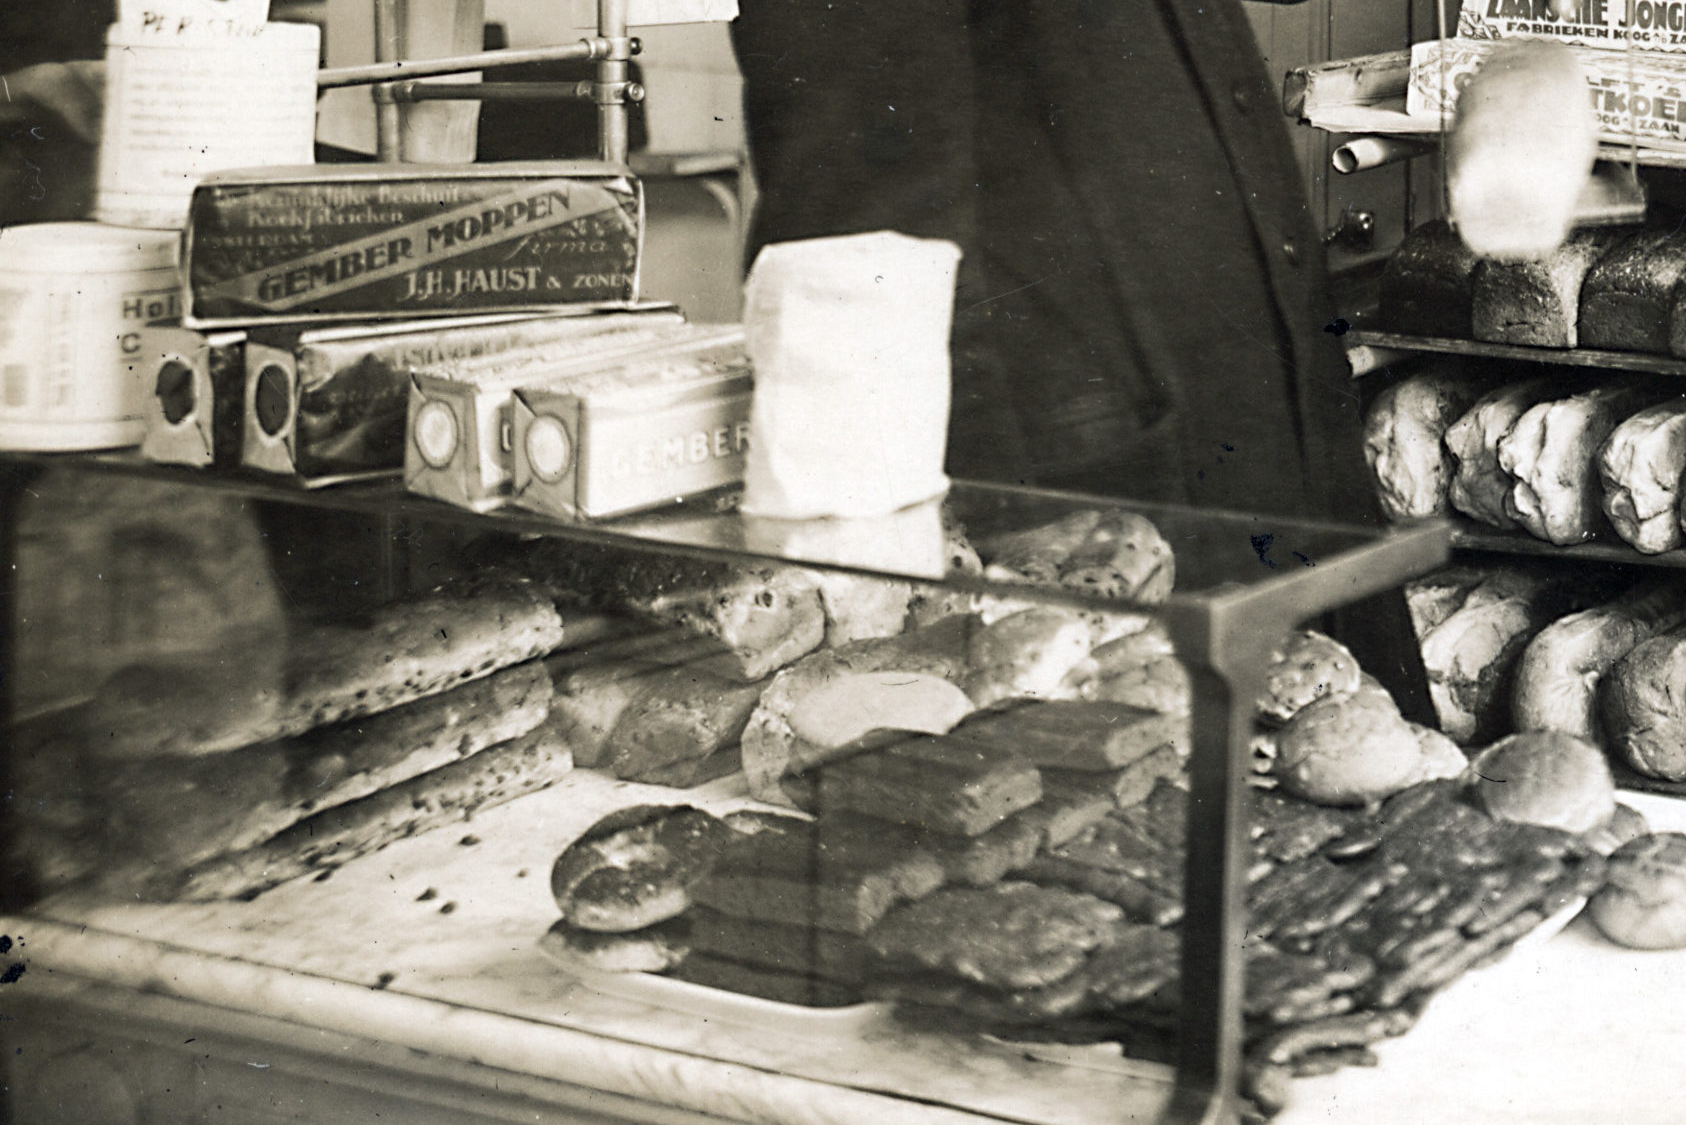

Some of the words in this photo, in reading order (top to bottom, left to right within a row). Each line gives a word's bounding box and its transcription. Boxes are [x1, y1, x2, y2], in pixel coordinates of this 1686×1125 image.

[1507, 22, 1608, 38] FABRIEKEN
[1614, 29, 1651, 42] KOOG
[1639, 119, 1680, 133] ZAAN
[258, 236, 414, 303] GEMBER
[427, 192, 569, 254] MOPPEN
[546, 275, 562, 290] &
[574, 273, 633, 289] ZONEN
